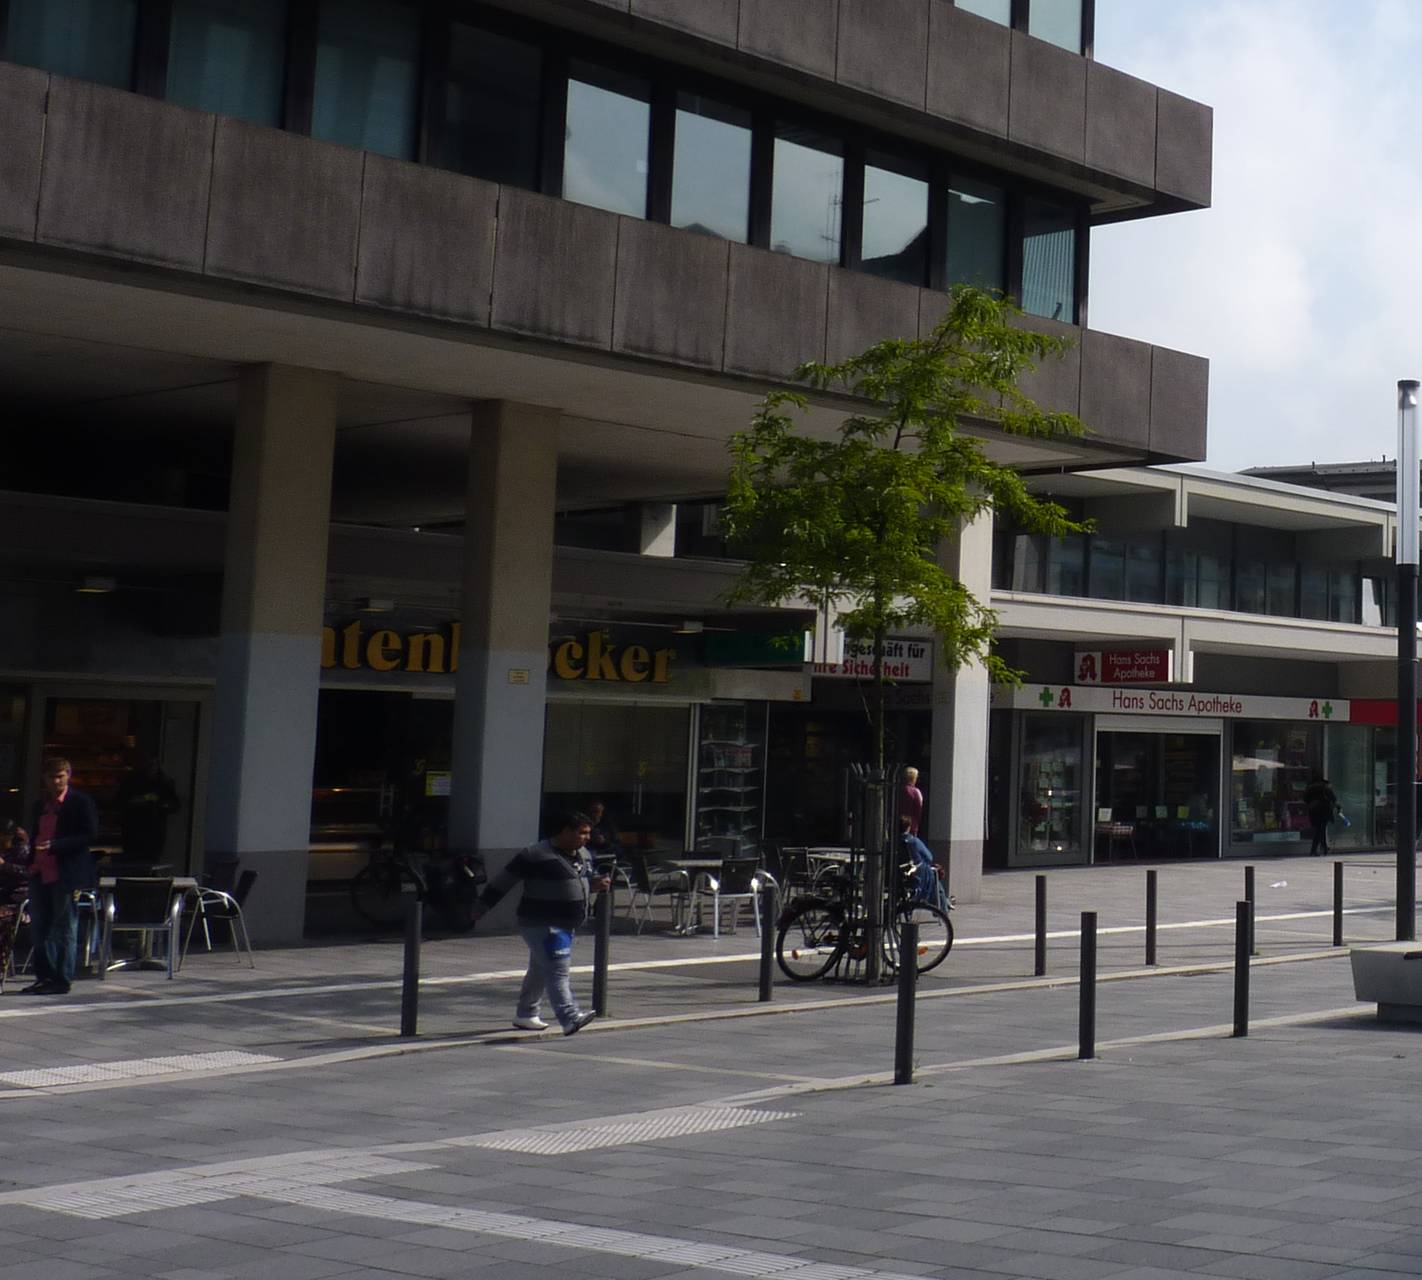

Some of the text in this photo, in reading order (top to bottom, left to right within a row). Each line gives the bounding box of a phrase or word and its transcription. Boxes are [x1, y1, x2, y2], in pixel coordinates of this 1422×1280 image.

[907, 643, 925, 658] für
[1109, 653, 1160, 665] Hans Sachs
[842, 659, 909, 677] Sicheheit
[1113, 666, 1155, 679] Apotheke
[1112, 690, 1243, 714] Hans Sachs Apotheke
